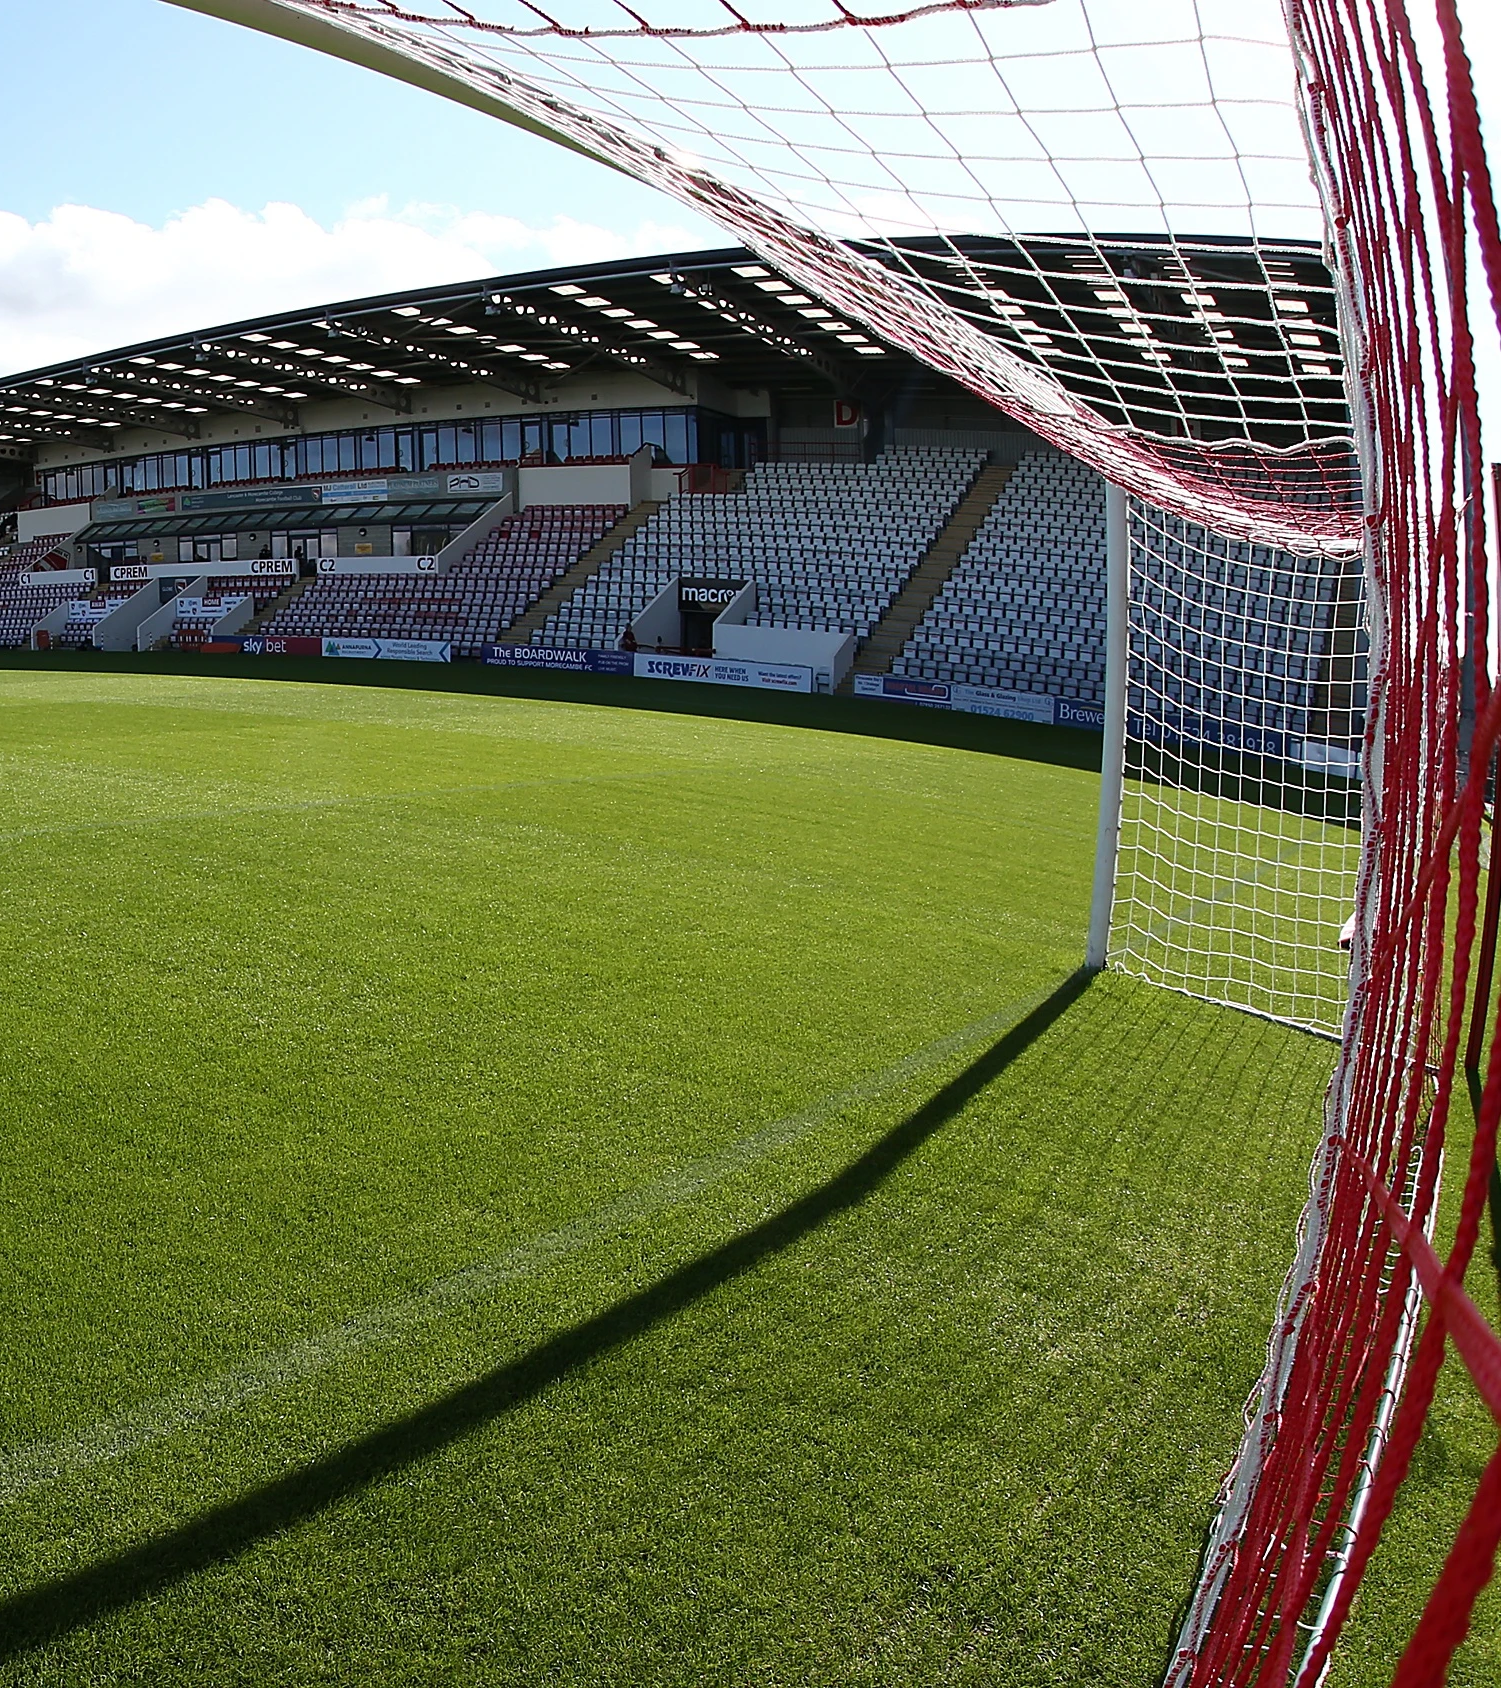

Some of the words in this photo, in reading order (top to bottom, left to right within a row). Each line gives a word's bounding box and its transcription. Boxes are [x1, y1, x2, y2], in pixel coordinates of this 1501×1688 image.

[835, 400, 860, 426] D
[251, 561, 293, 573] CPREM
[320, 559, 335, 572] C2
[417, 557, 435, 570] C2
[21, 574, 30, 584] C1
[84, 570, 94, 580] C1
[113, 567, 148, 579] CPREM
[243, 638, 262, 655] sky
[266, 638, 287, 653] bet
[492, 647, 511, 658] The
[514, 648, 587, 663] BOARDWALK
[517, 660, 544, 668] SUPPORT
[545, 662, 583, 670] MORECAMBE
[647, 660, 712, 678] SCREWFIX
[975, 690, 990, 698] Glass
[996, 693, 1017, 702] Glazing
[970, 705, 1000, 715] 01524
[1059, 703, 1105, 724] Brewe
[1133, 717, 1156, 737] Tel
